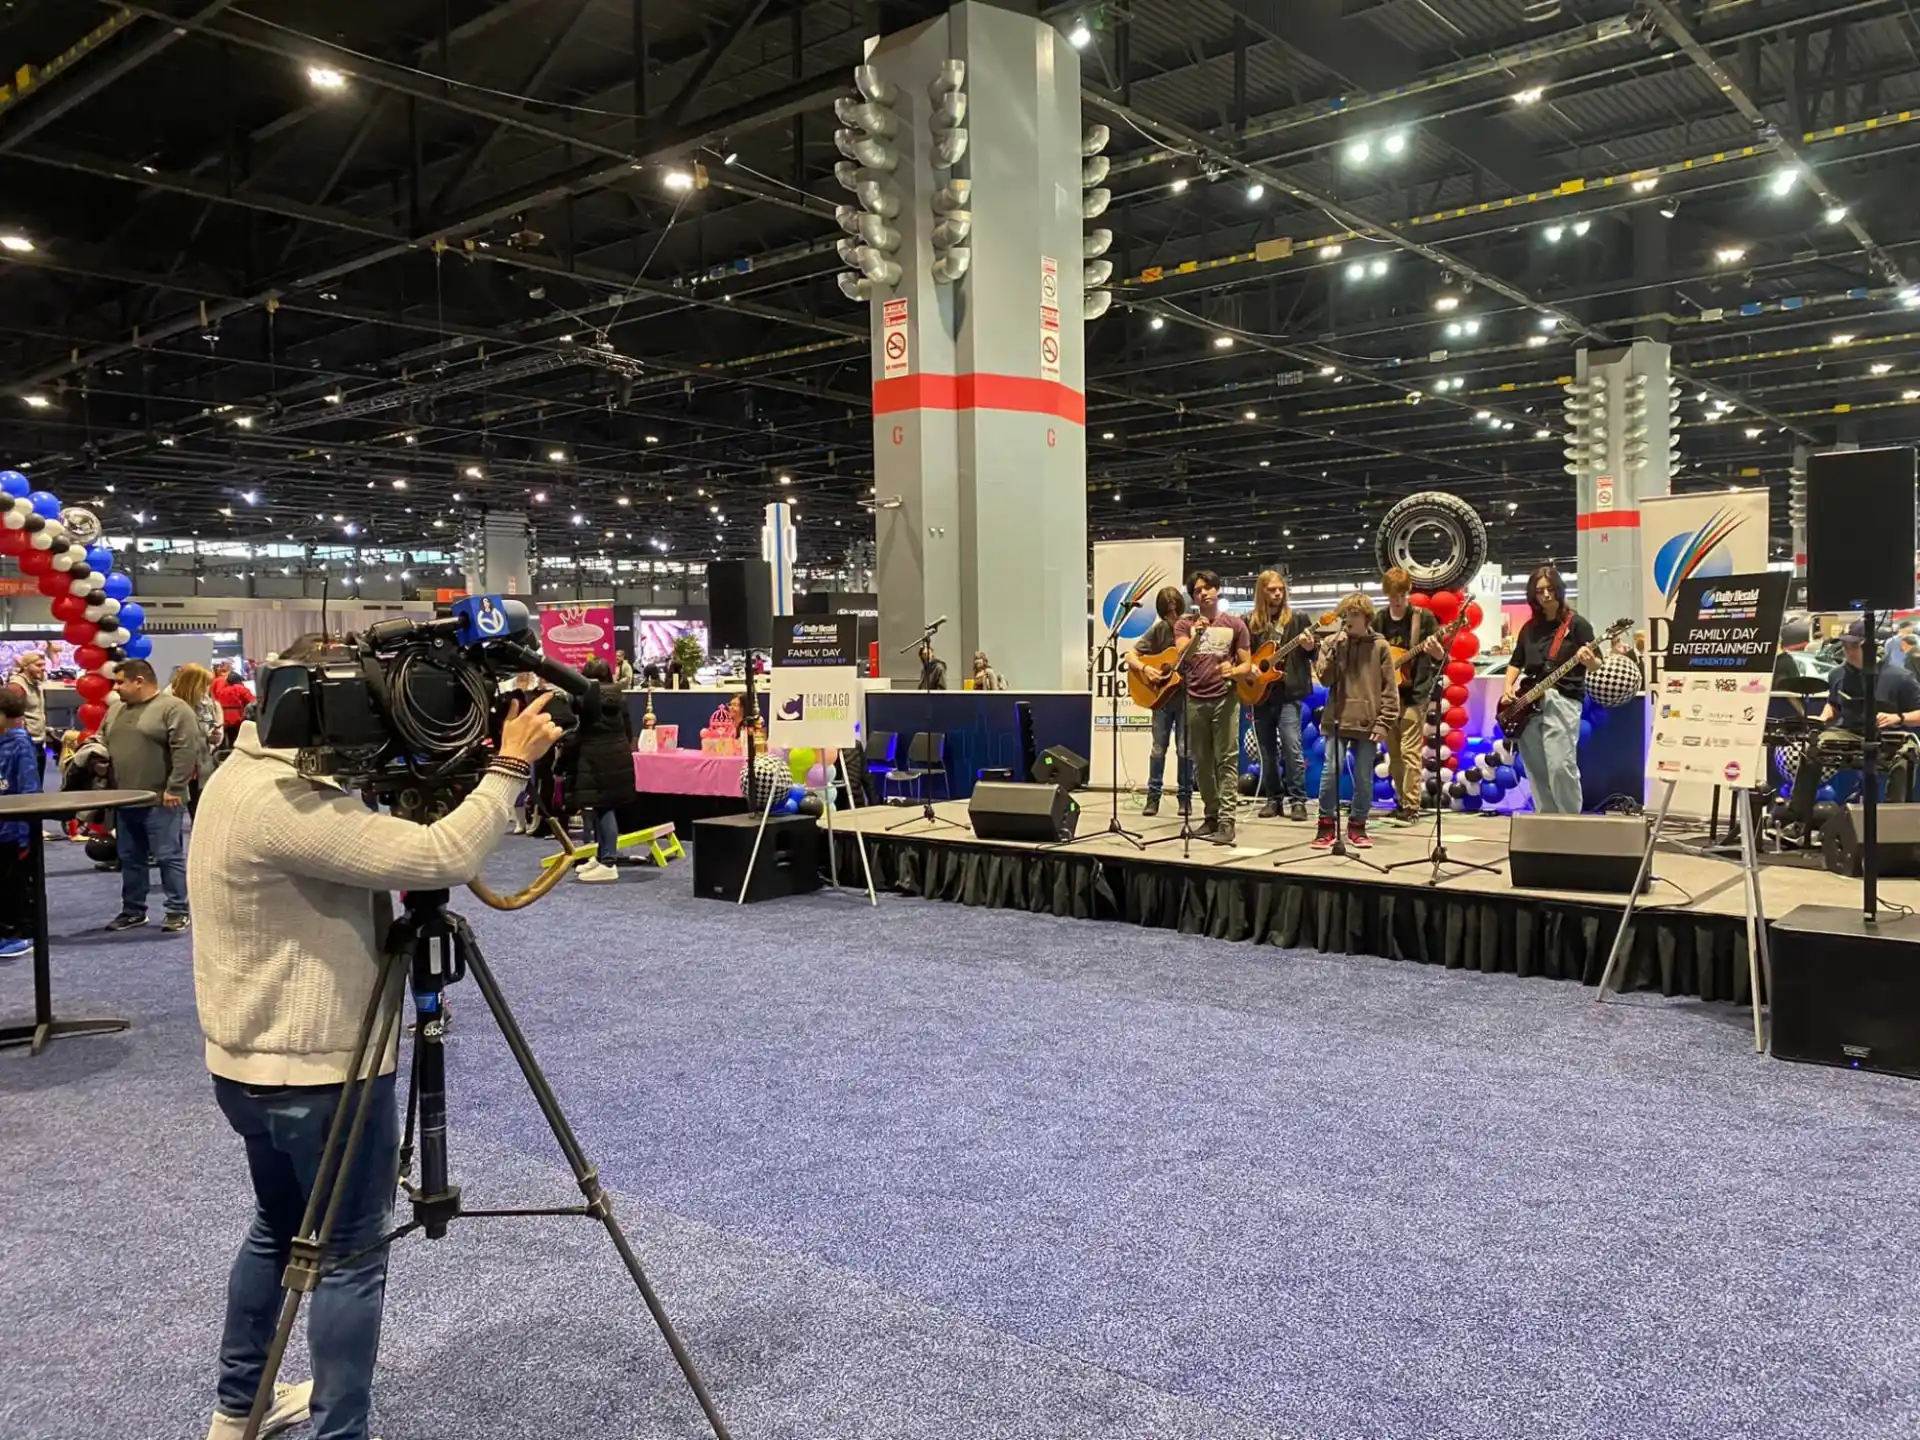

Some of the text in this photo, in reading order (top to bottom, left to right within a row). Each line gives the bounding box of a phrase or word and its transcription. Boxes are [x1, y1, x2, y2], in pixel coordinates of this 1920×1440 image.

[892, 425, 904, 446] G
[1046, 428, 1056, 448] G
[1601, 533, 1608, 543] H
[1714, 588, 1760, 603] Daily Herald
[804, 624, 837, 633] Daily Herald
[1689, 628, 1759, 640] FAMILY DAY
[787, 648, 841, 657] FAMILY DAY
[1672, 641, 1772, 655] ENTERTAINMENT
[1689, 657, 1748, 666] PRESENTED BY
[812, 693, 850, 706] CHICAGO
[424, 1025, 443, 1036] abc
